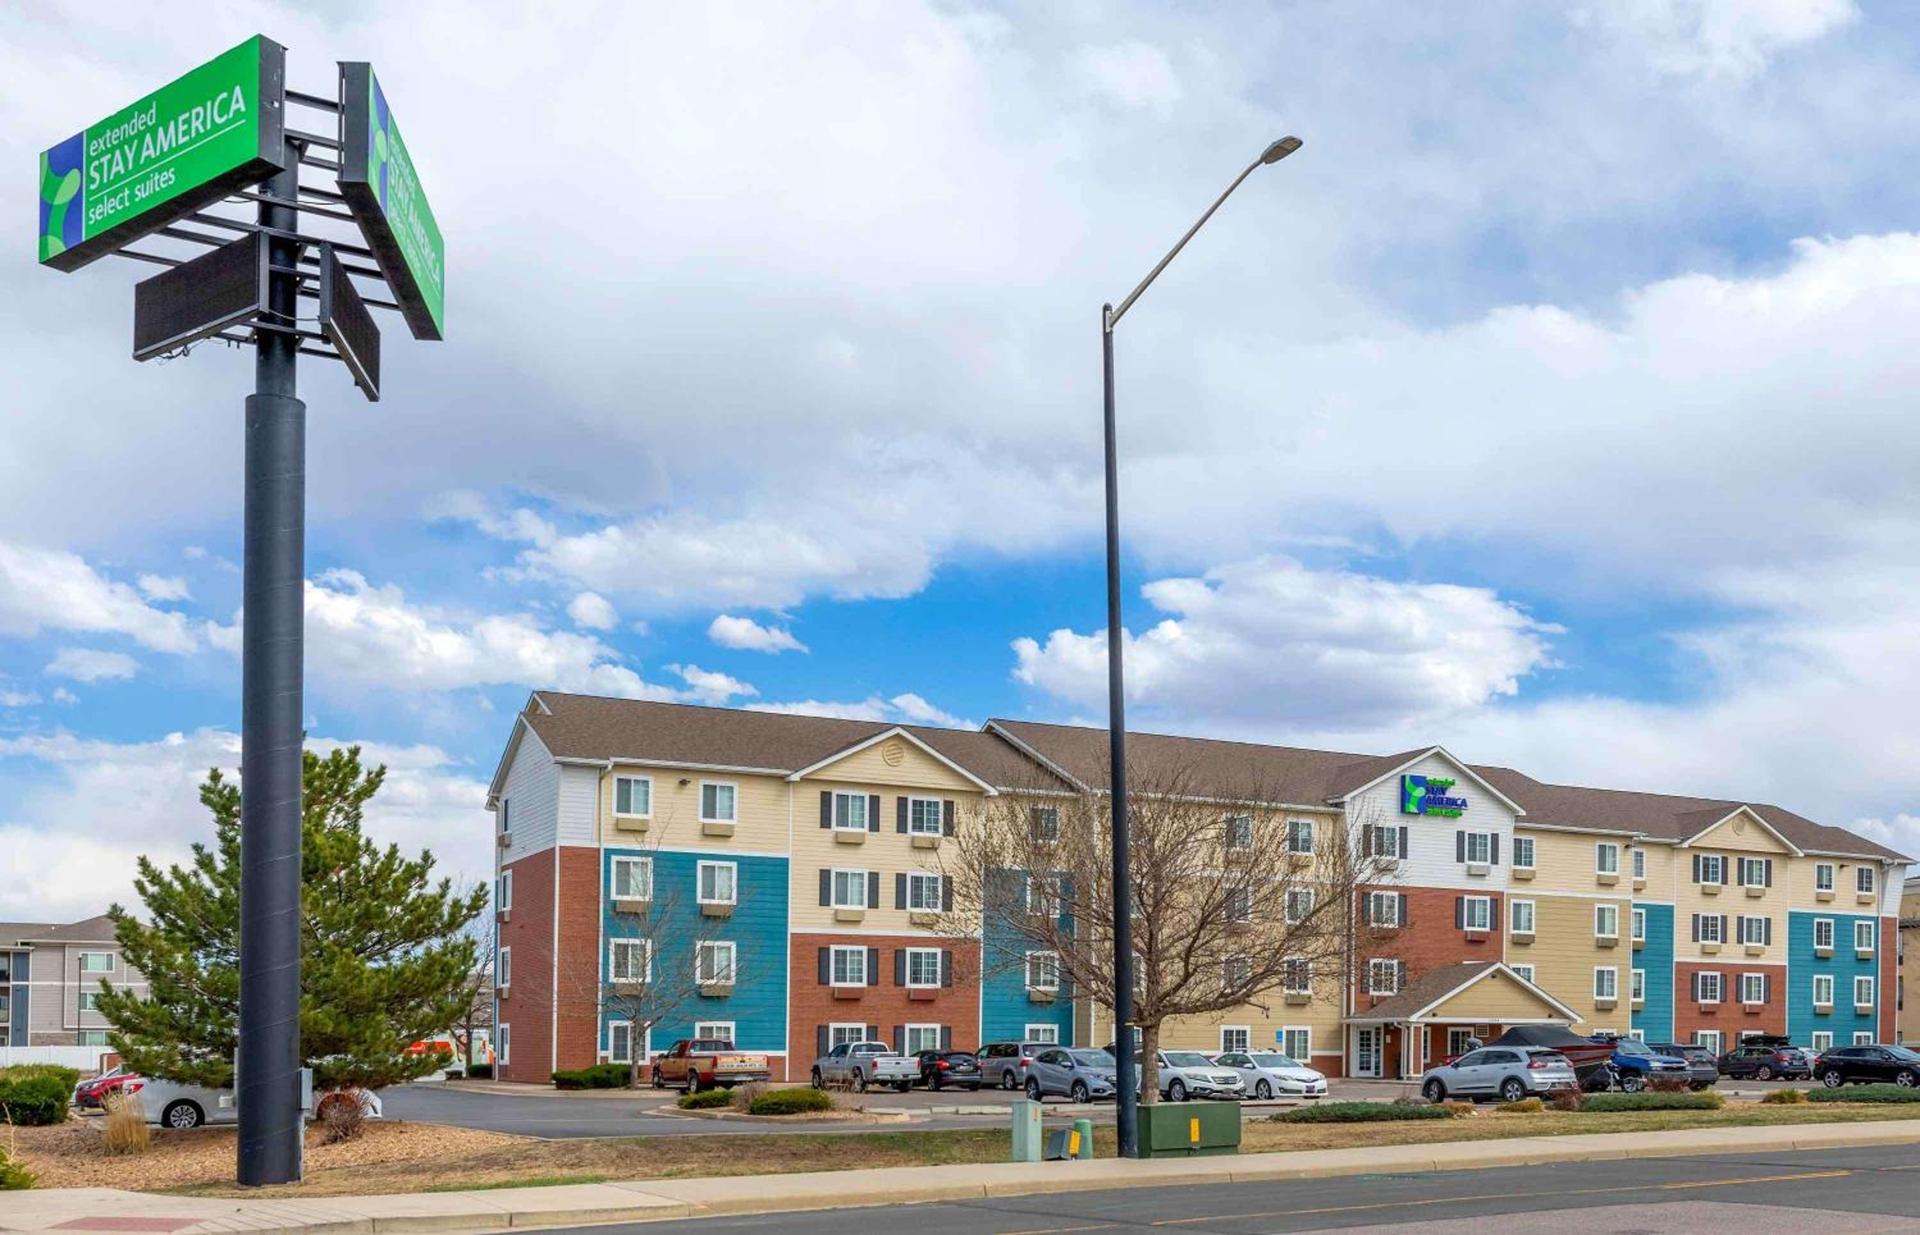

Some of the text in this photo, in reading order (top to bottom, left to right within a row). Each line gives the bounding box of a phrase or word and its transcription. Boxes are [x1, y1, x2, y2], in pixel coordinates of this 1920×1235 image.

[89, 101, 157, 157] extended
[89, 84, 246, 190] STAY AMERICA
[88, 167, 176, 225] select suites
